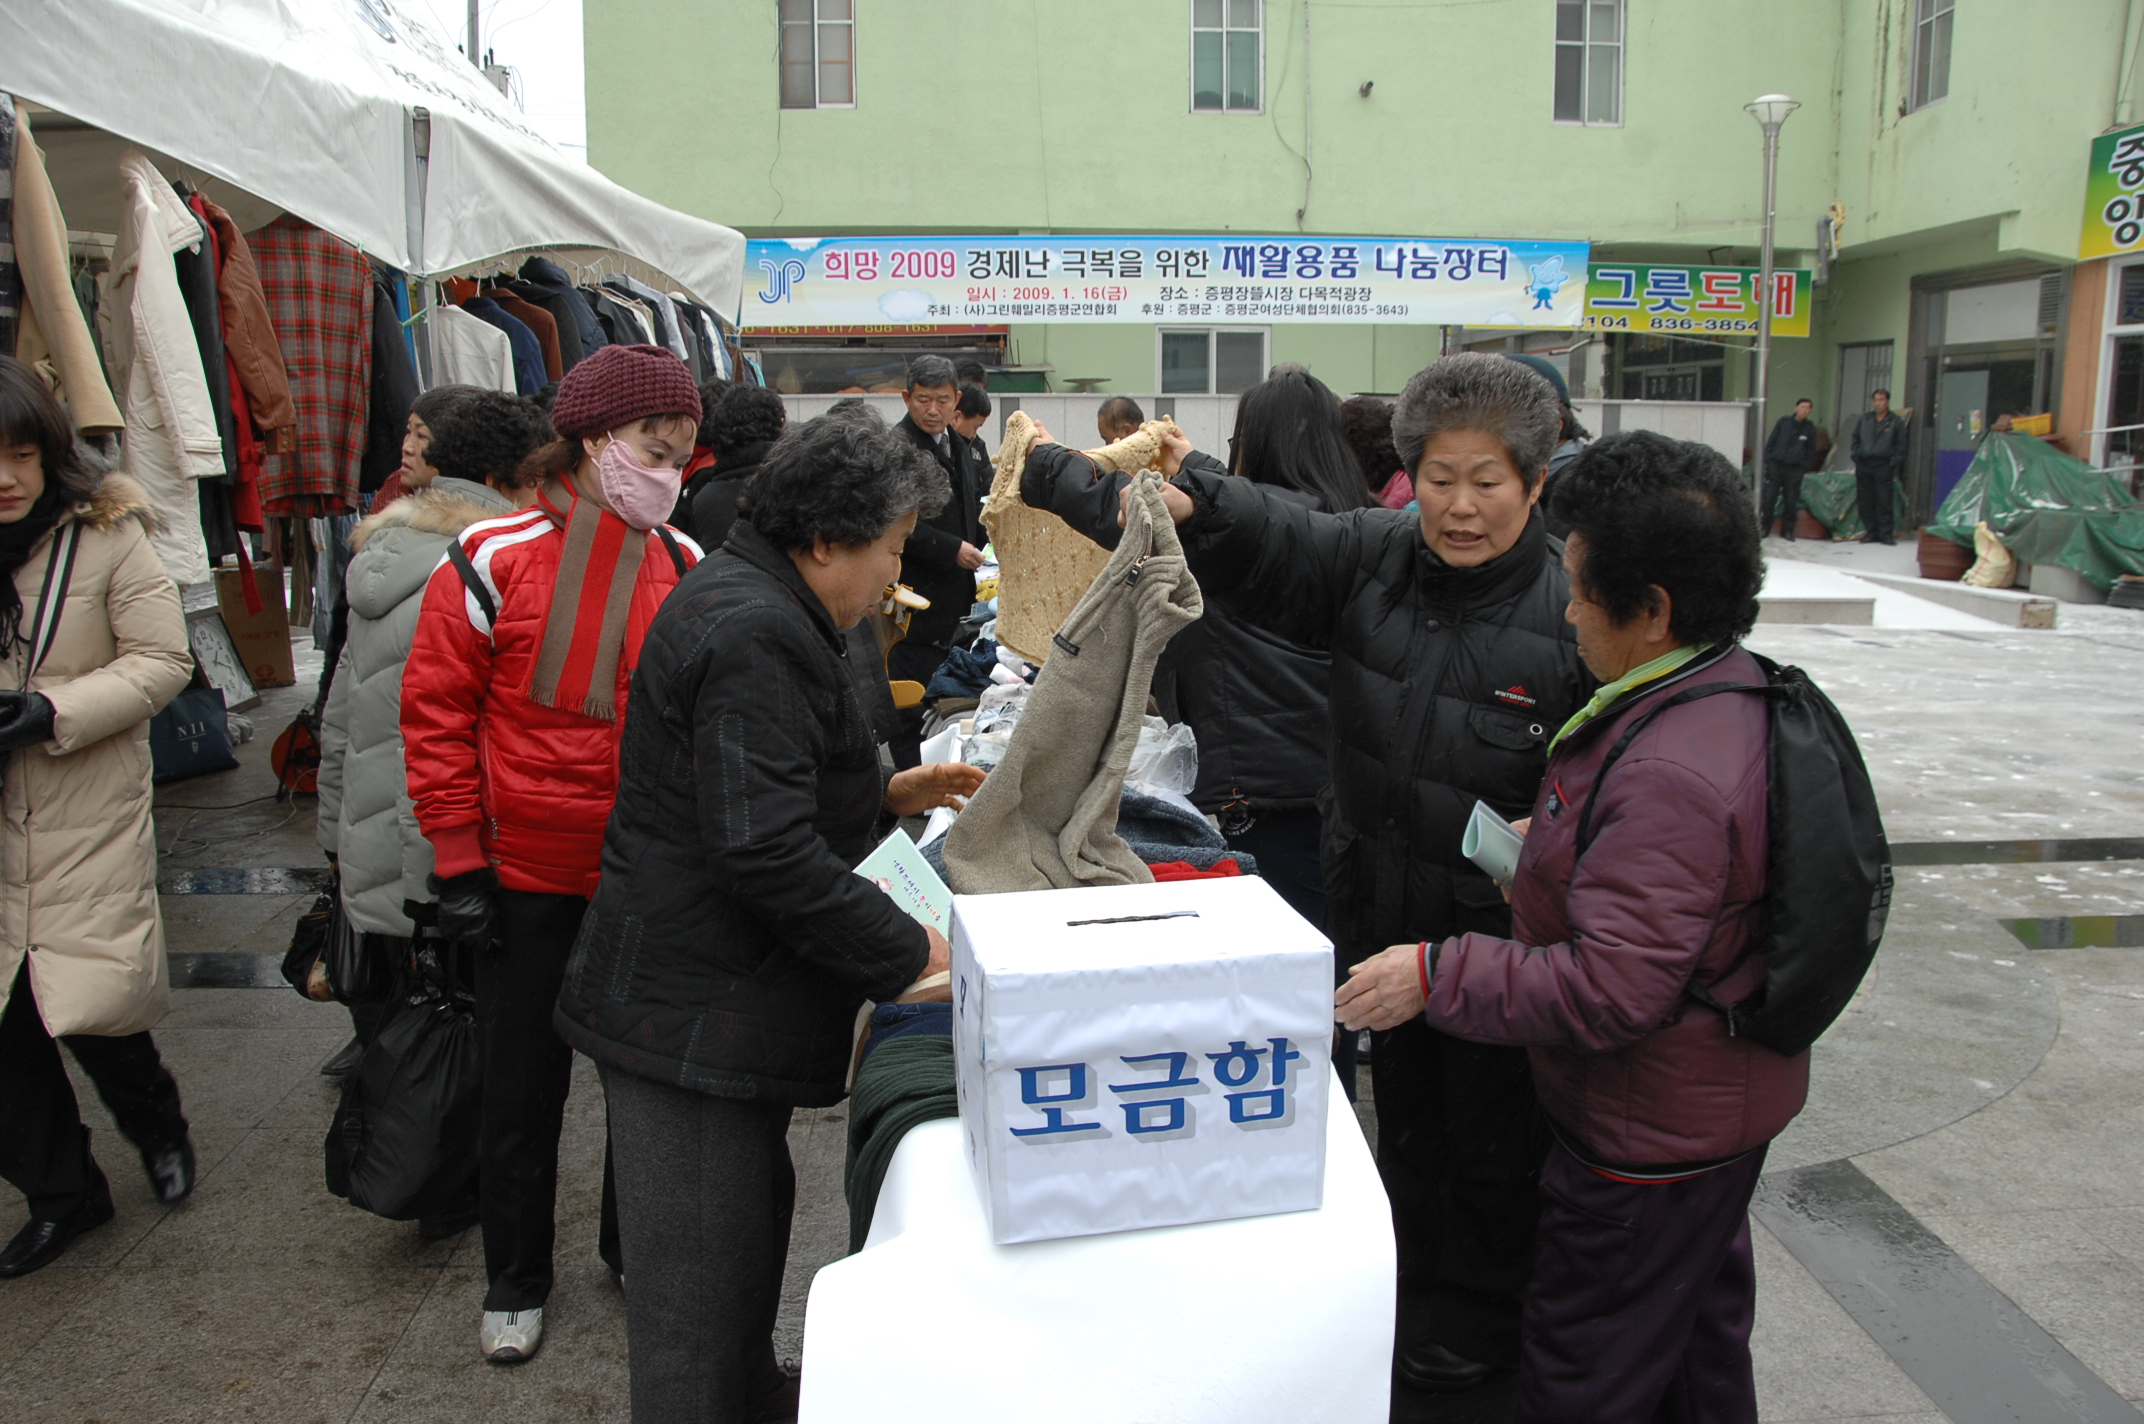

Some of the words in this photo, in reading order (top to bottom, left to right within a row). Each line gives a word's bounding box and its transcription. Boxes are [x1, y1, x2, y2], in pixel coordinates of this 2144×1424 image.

[824, 249, 880, 281] 희망
[889, 249, 957, 280] 2009
[966, 249, 1050, 280] 경제난
[1060, 249, 1143, 280] 극복을
[1154, 248, 1210, 280] 위한
[1222, 243, 1360, 280] 재활용품
[1374, 245, 1509, 281] 나눔장터
[967, 286, 996, 301] 일시
[1013, 287, 1055, 300] 2009.
[1083, 286, 1128, 301] 16(금)
[1160, 286, 1189, 301] 장소
[1205, 286, 1294, 301] 증평장뜰시장
[1299, 286, 1372, 301] 다목적광장
[927, 304, 950, 317] 주최
[1141, 304, 1165, 316] 후원
[1177, 304, 1212, 316] 증평군
[1650, 317, 1759, 332] 836-3854
[1495, 690, 1536, 705] WINTERSPORT
[1009, 1037, 1305, 1141] 모금함
